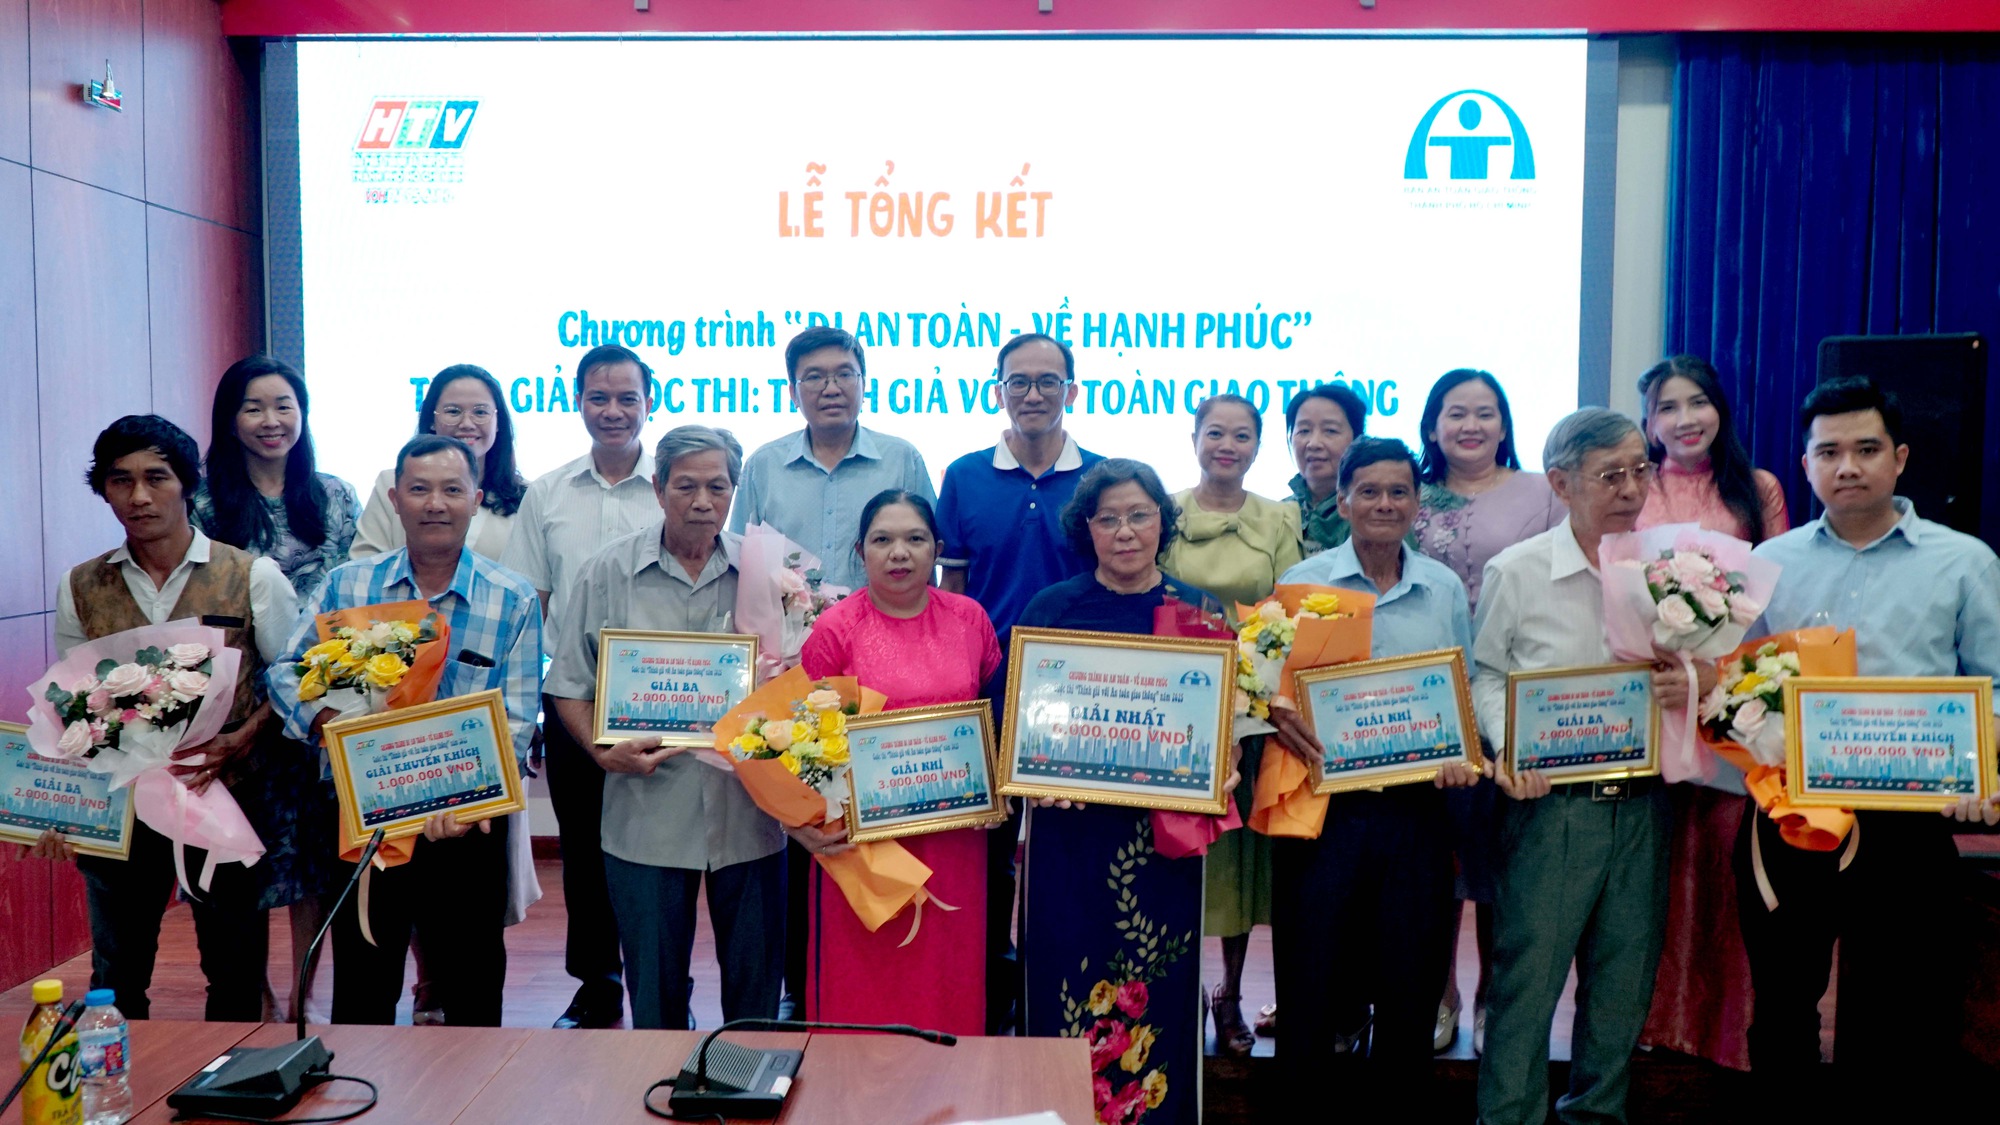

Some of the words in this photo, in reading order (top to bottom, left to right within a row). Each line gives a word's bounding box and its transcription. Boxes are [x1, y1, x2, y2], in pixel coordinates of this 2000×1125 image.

[361, 104, 476, 145] HTV
[778, 161, 827, 237] LỄ
[844, 160, 954, 237] TỔNG
[976, 162, 1053, 238] KẾT
[558, 309, 686, 356] Chương
[694, 309, 776, 347] trình
[855, 311, 900, 347] AN
[907, 302, 1000, 348] TOÀN
[1083, 312, 1185, 358] HẠNH
[1199, 303, 1312, 350] PHÚC”
[691, 378, 759, 414] THI:
[888, 366, 949, 415] GIẢ
[1081, 369, 1175, 416] TOÀN
[1276, 370, 1399, 416] TNG
[1038, 659, 1066, 669] HTV
[682, 682, 699, 692] BA
[631, 692, 694, 703] 2.000.000
[698, 694, 724, 704] VND
[1071, 702, 1109, 722] GIẢI
[1115, 707, 1165, 727] NHẤT
[1147, 729, 1186, 745] VND
[1342, 723, 1406, 741] 3.000.000
[1410, 719, 1438, 732] VND
[1540, 726, 1599, 740] 2.000.000
[1603, 723, 1629, 735] VND
[444, 746, 480, 762] KHÍCH
[1831, 745, 1907, 757] 1.000.000
[1912, 746, 1945, 757] VND
[378, 768, 442, 790] 1.000.000
[446, 761, 475, 775] VND
[878, 773, 938, 790] 3.000.000
[941, 769, 967, 780] VND
[14, 787, 76, 805] 2.000.000
[80, 797, 106, 810] VND
